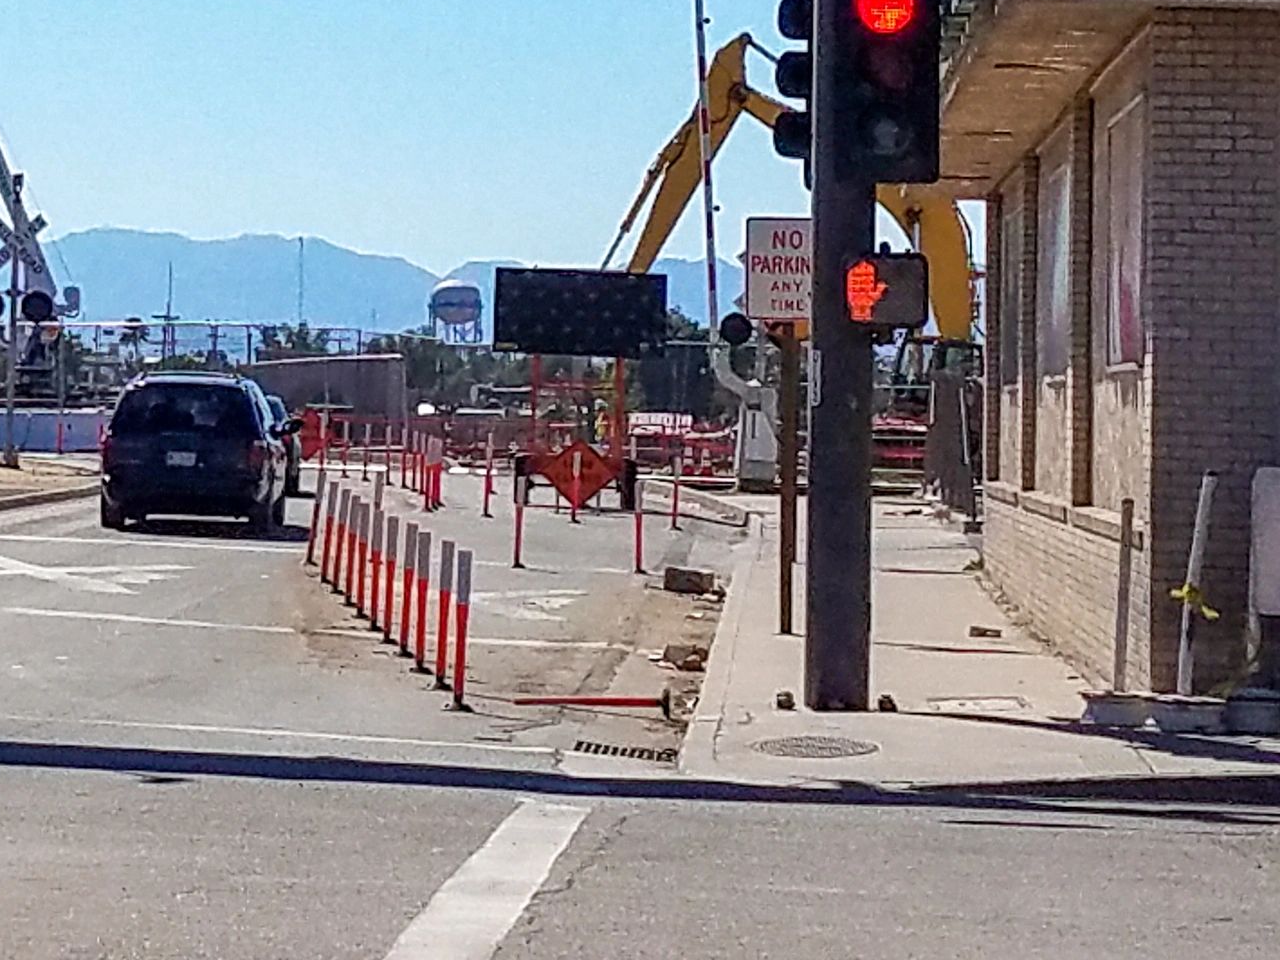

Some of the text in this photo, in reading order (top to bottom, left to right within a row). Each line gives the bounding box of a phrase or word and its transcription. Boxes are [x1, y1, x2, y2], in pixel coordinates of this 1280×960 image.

[772, 230, 803, 250] NO
[751, 254, 811, 275] PARKIN
[770, 280, 803, 293] ANY
[771, 298, 805, 311] TIME
